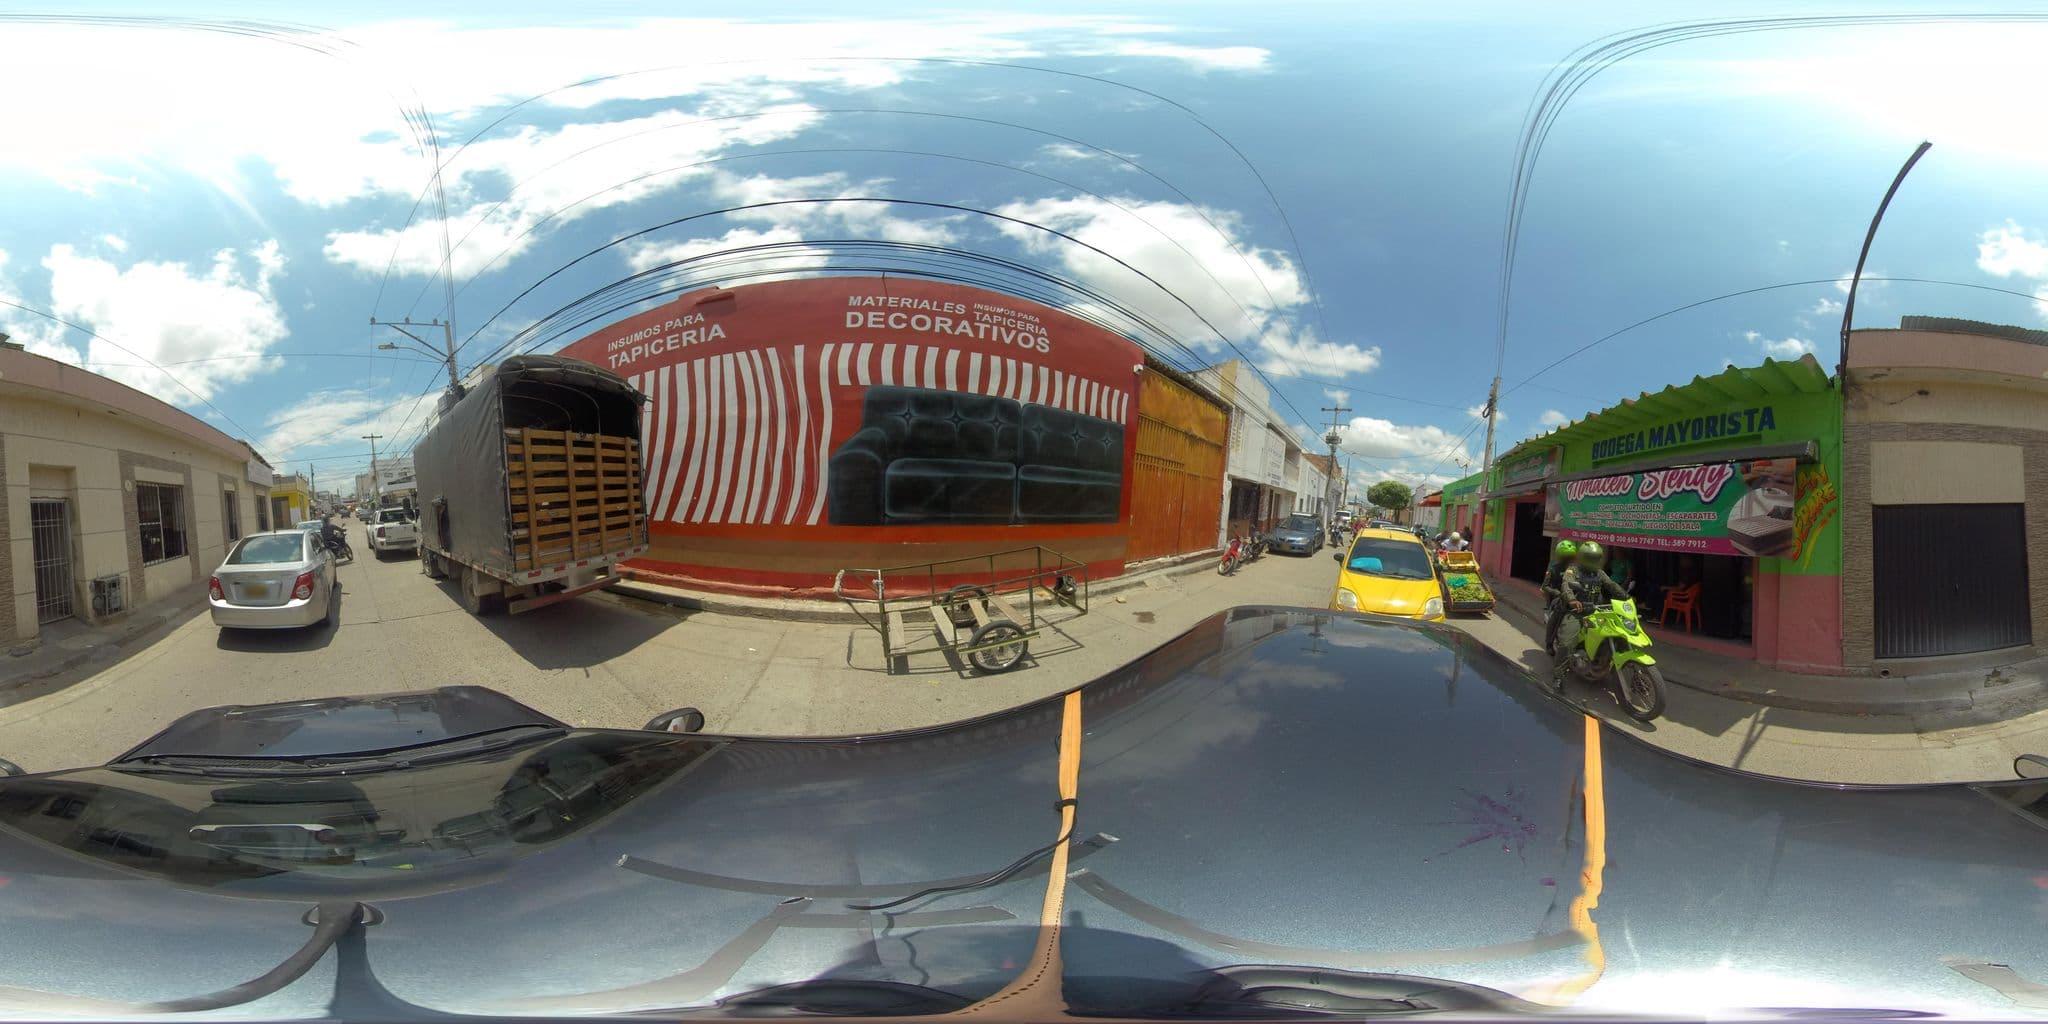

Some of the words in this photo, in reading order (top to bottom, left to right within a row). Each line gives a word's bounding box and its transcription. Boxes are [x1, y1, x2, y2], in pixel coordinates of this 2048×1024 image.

[848, 296, 967, 315] MATERIALES
[973, 302, 1016, 317] INSUMOS
[1017, 312, 1040, 324] PARA
[608, 324, 661, 352] INSUMOS
[665, 312, 704, 331] PARA
[846, 311, 1050, 353] DECORATIVOS
[973, 312, 1048, 336] TAPICERIA
[608, 323, 726, 369] TAPICERIA
[1591, 430, 1645, 460] BODEGA
[1648, 405, 1776, 449] MAYORISTA
[1666, 511, 1718, 521] ESCAPARATES
[1669, 521, 1680, 530] DE
[1680, 522, 1701, 531] SALA
[1657, 538, 1671, 546] TEL:
[1687, 540, 1707, 548] 7912
